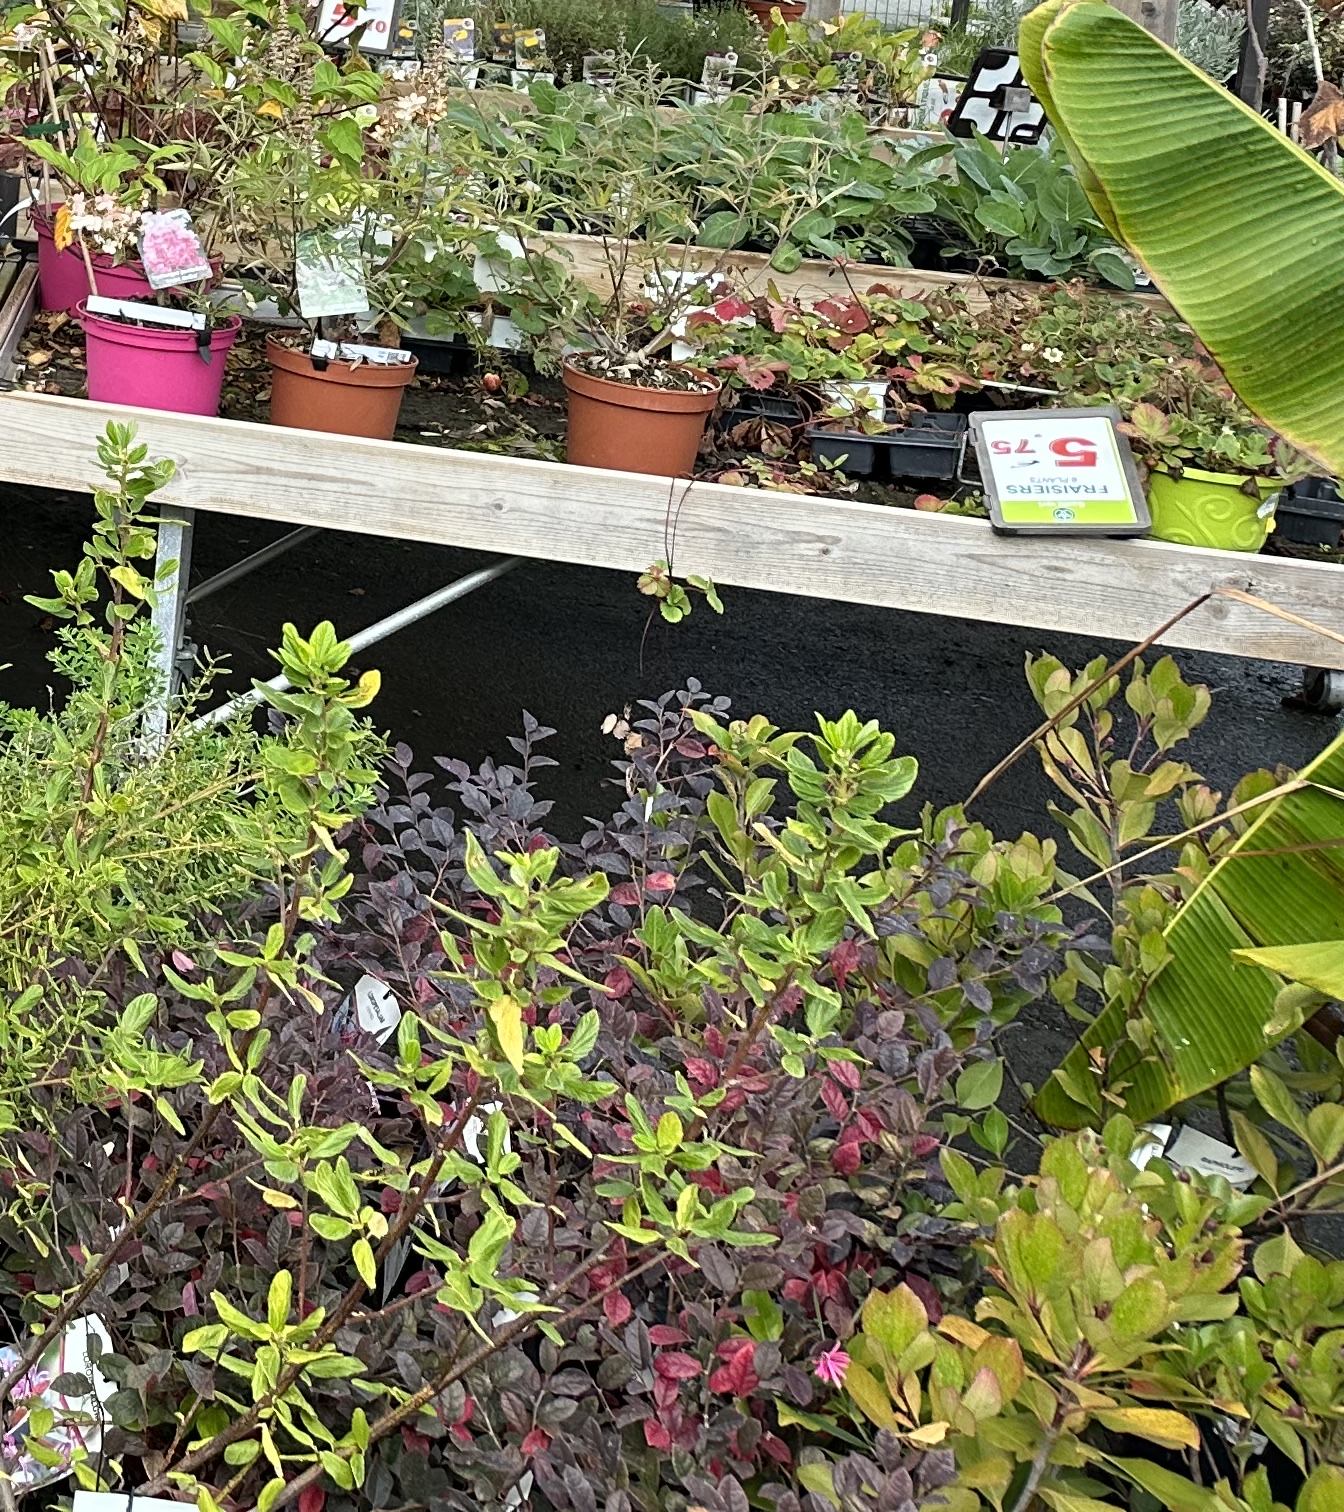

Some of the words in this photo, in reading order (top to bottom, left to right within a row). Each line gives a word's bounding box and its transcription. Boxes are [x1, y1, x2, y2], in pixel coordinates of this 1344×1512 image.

[990, 438, 1037, 455] 75
[1048, 436, 1098, 468] 5
[1006, 484, 1109, 495] FRAISIERS
